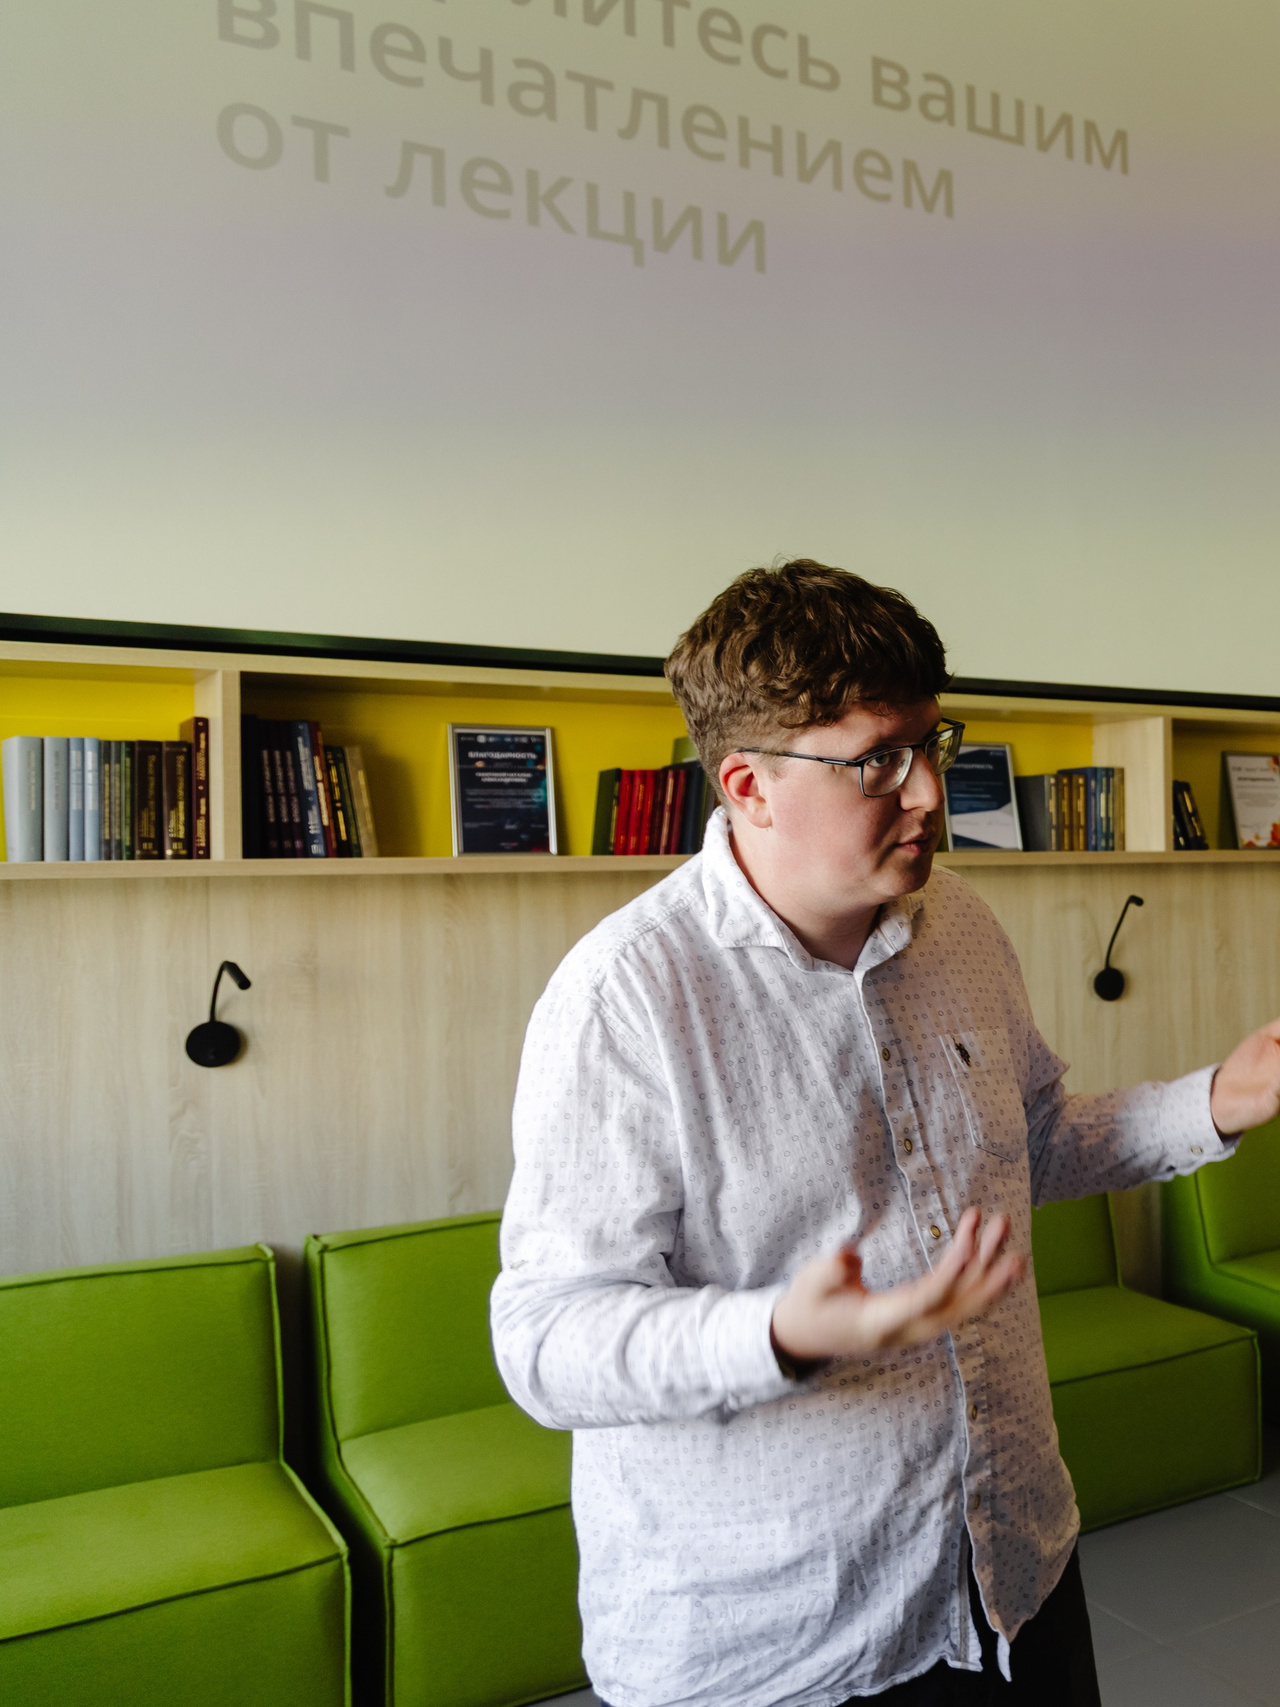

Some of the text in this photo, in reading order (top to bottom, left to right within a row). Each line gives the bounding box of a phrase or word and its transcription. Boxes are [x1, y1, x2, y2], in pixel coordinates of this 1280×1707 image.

[217, 0, 954, 218] впечатлением
[217, 103, 766, 273] от лекции
[871, 55, 1130, 175] вашим
